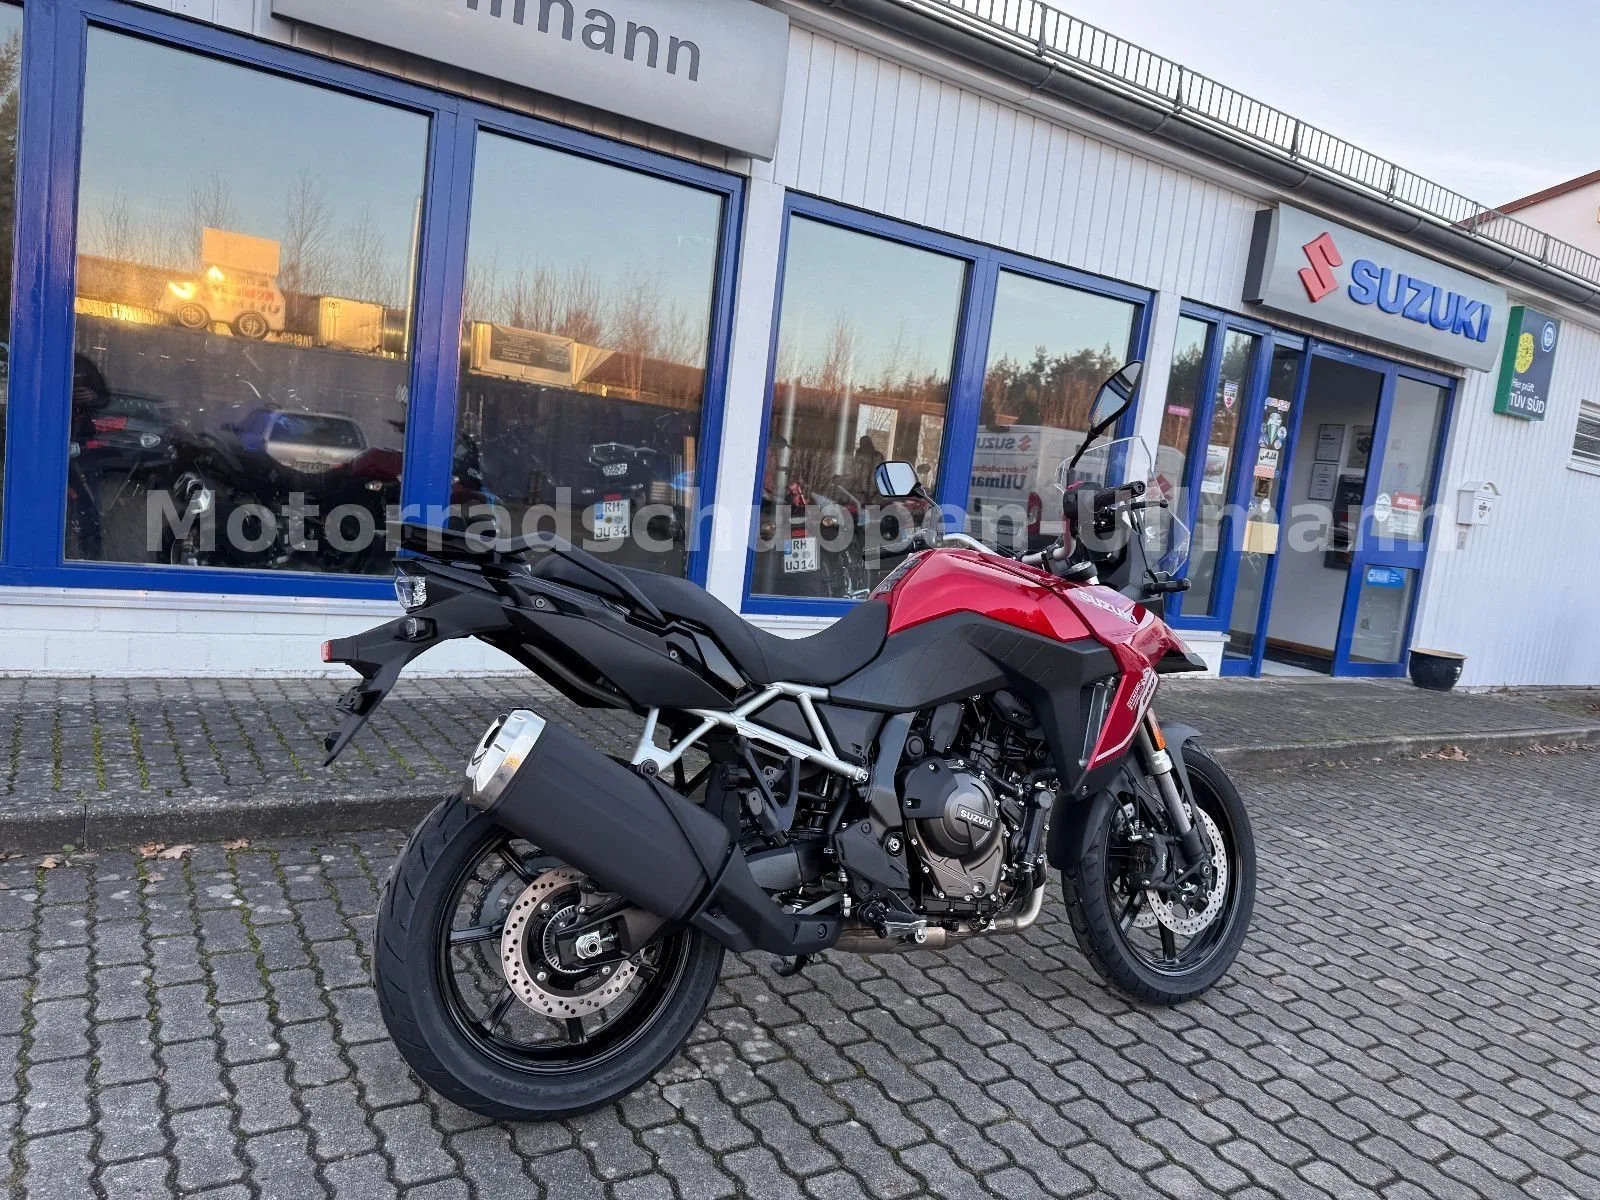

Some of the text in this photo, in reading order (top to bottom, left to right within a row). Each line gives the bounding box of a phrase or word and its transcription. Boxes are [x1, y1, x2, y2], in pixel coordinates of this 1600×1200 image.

[1347, 259, 1492, 343] SUZUKI
[1510, 391, 1545, 413] TÜV SÜD
[793, 539, 807, 550] RH
[960, 809, 993, 828] SUZUKI
